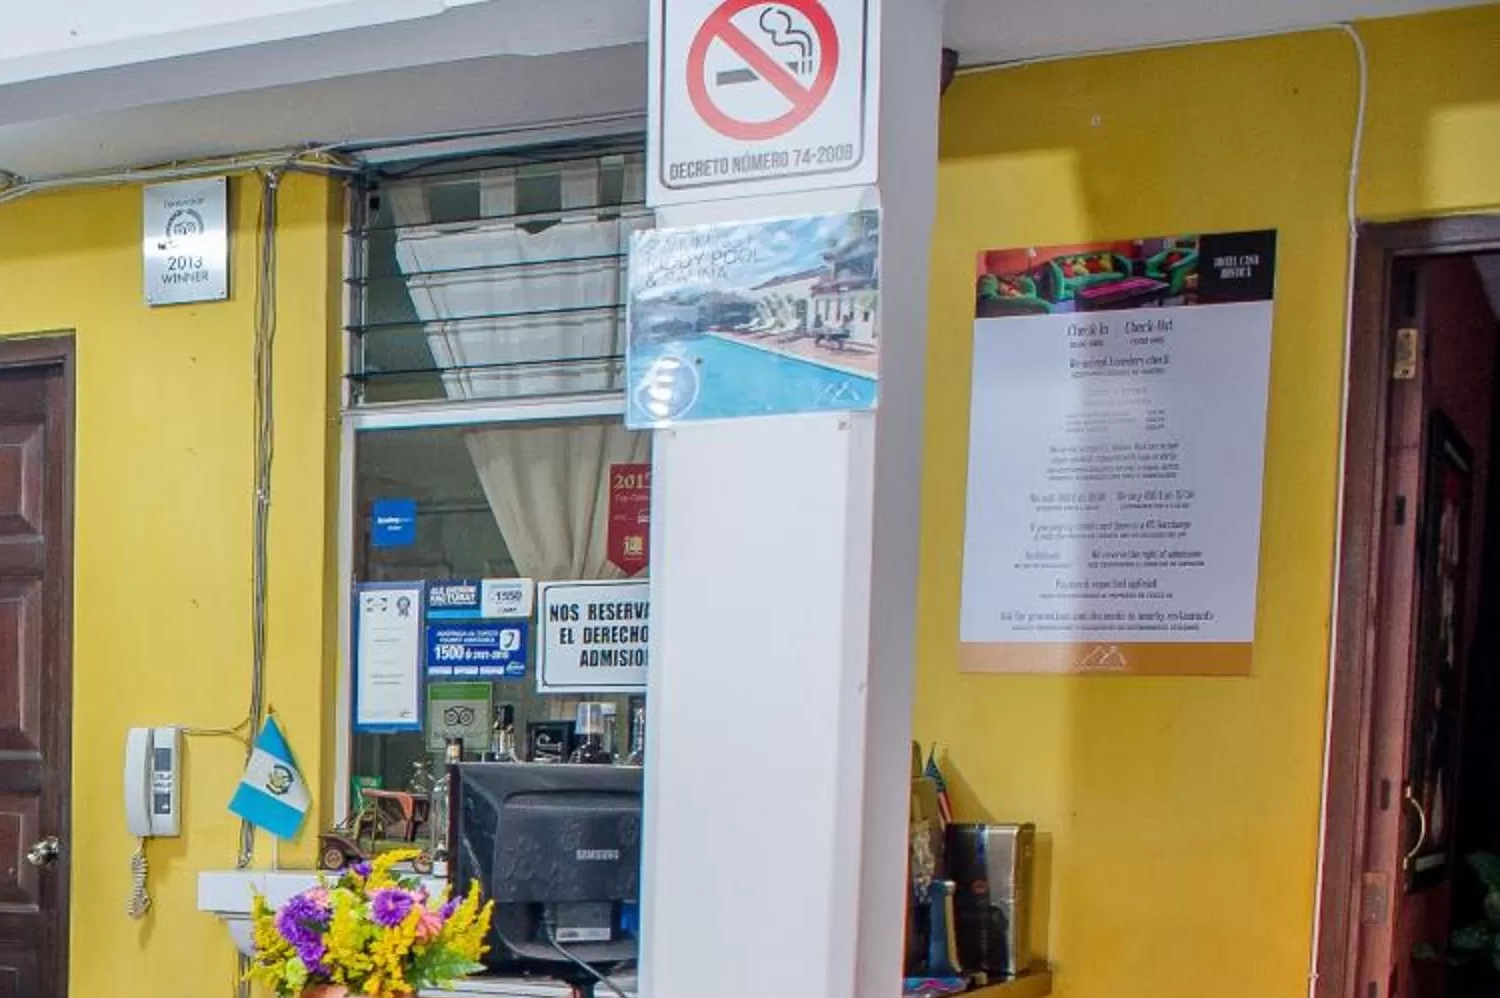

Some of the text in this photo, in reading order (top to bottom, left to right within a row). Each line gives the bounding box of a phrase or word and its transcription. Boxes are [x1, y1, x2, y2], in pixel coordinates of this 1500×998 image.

[669, 158, 729, 180] DECRETO
[731, 149, 789, 174] NÚMERO
[161, 269, 209, 284] WINNER
[550, 603, 579, 622] NOS
[560, 625, 649, 645] EL DERECHO
[435, 644, 464, 660] 1500
